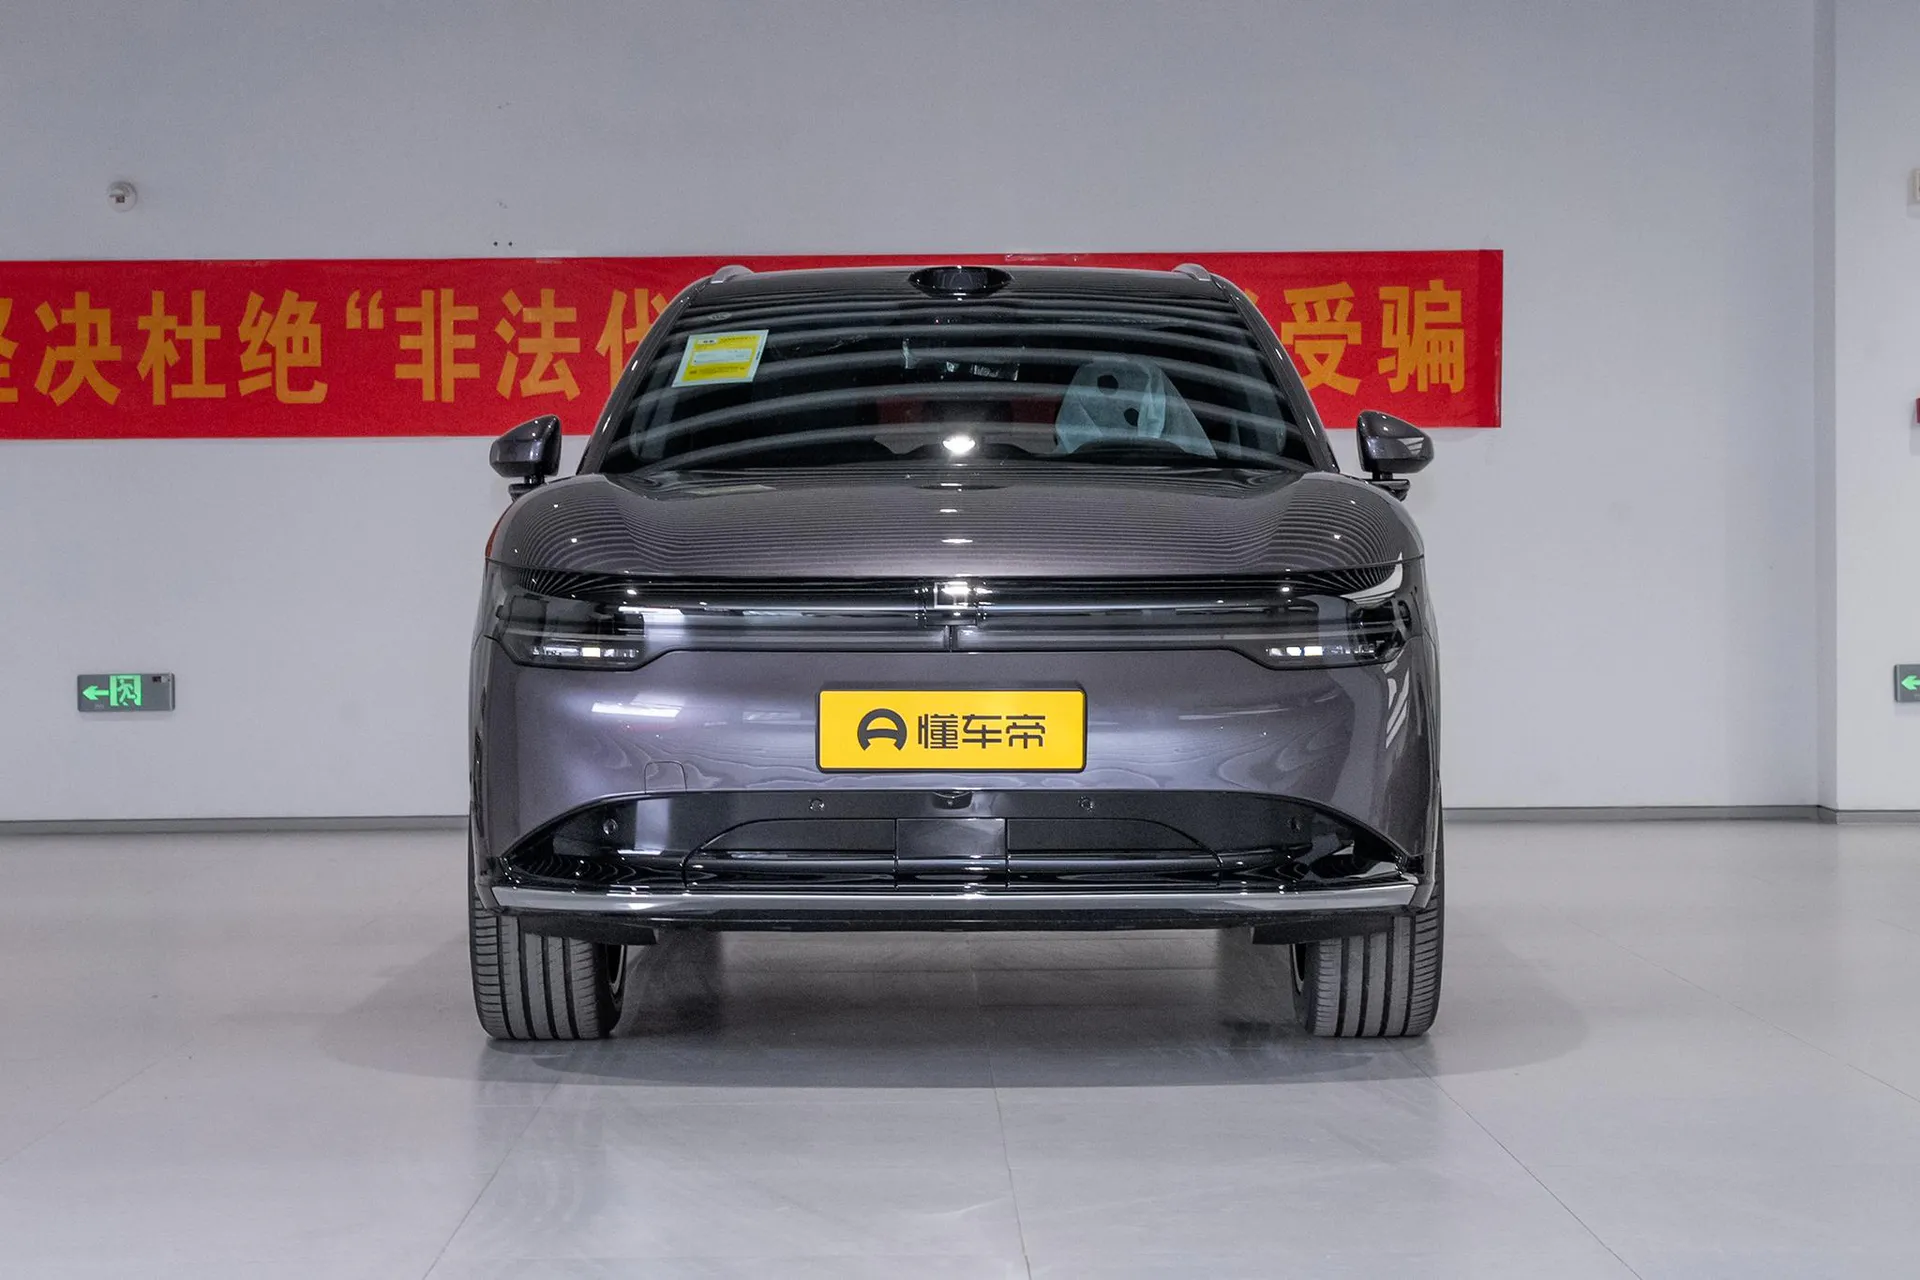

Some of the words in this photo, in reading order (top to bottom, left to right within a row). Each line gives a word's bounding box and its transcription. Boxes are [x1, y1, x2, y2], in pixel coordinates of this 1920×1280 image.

[0, 288, 668, 406] 决杜绝“非法代
[1246, 280, 1465, 396] 受骗
[917, 713, 1046, 749] 懂车帝
